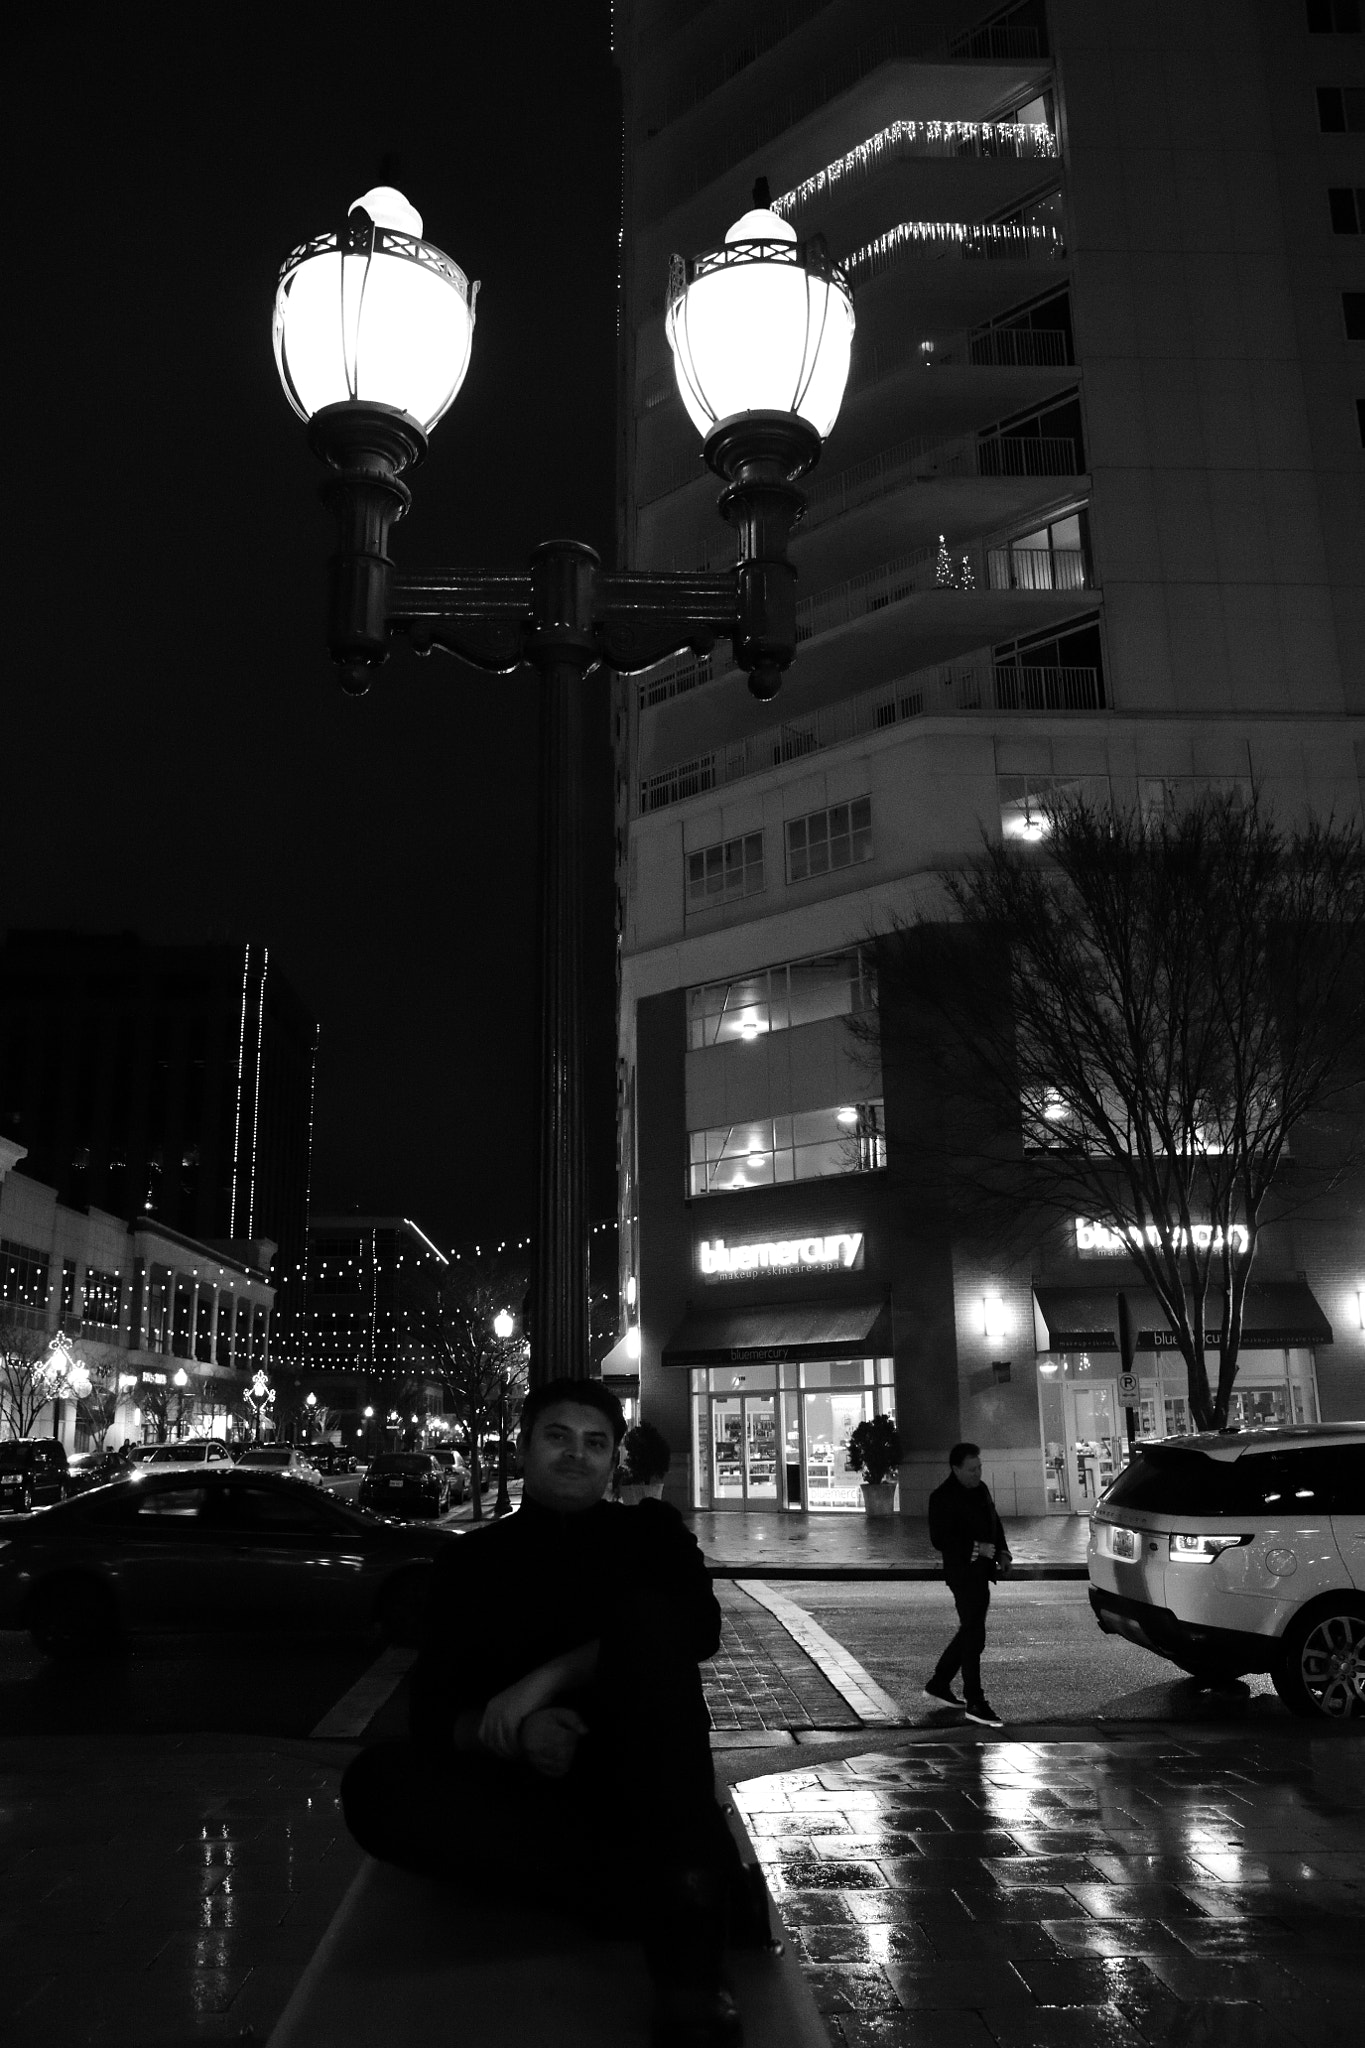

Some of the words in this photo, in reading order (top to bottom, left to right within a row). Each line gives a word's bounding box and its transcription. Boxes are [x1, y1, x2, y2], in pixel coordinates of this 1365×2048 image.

[700, 1232, 864, 1273] bluemercury
[720, 1269, 758, 1280] makeup
[767, 1264, 812, 1276] skincare
[821, 1262, 839, 1272] spa
[730, 1347, 789, 1361] bluemercury
